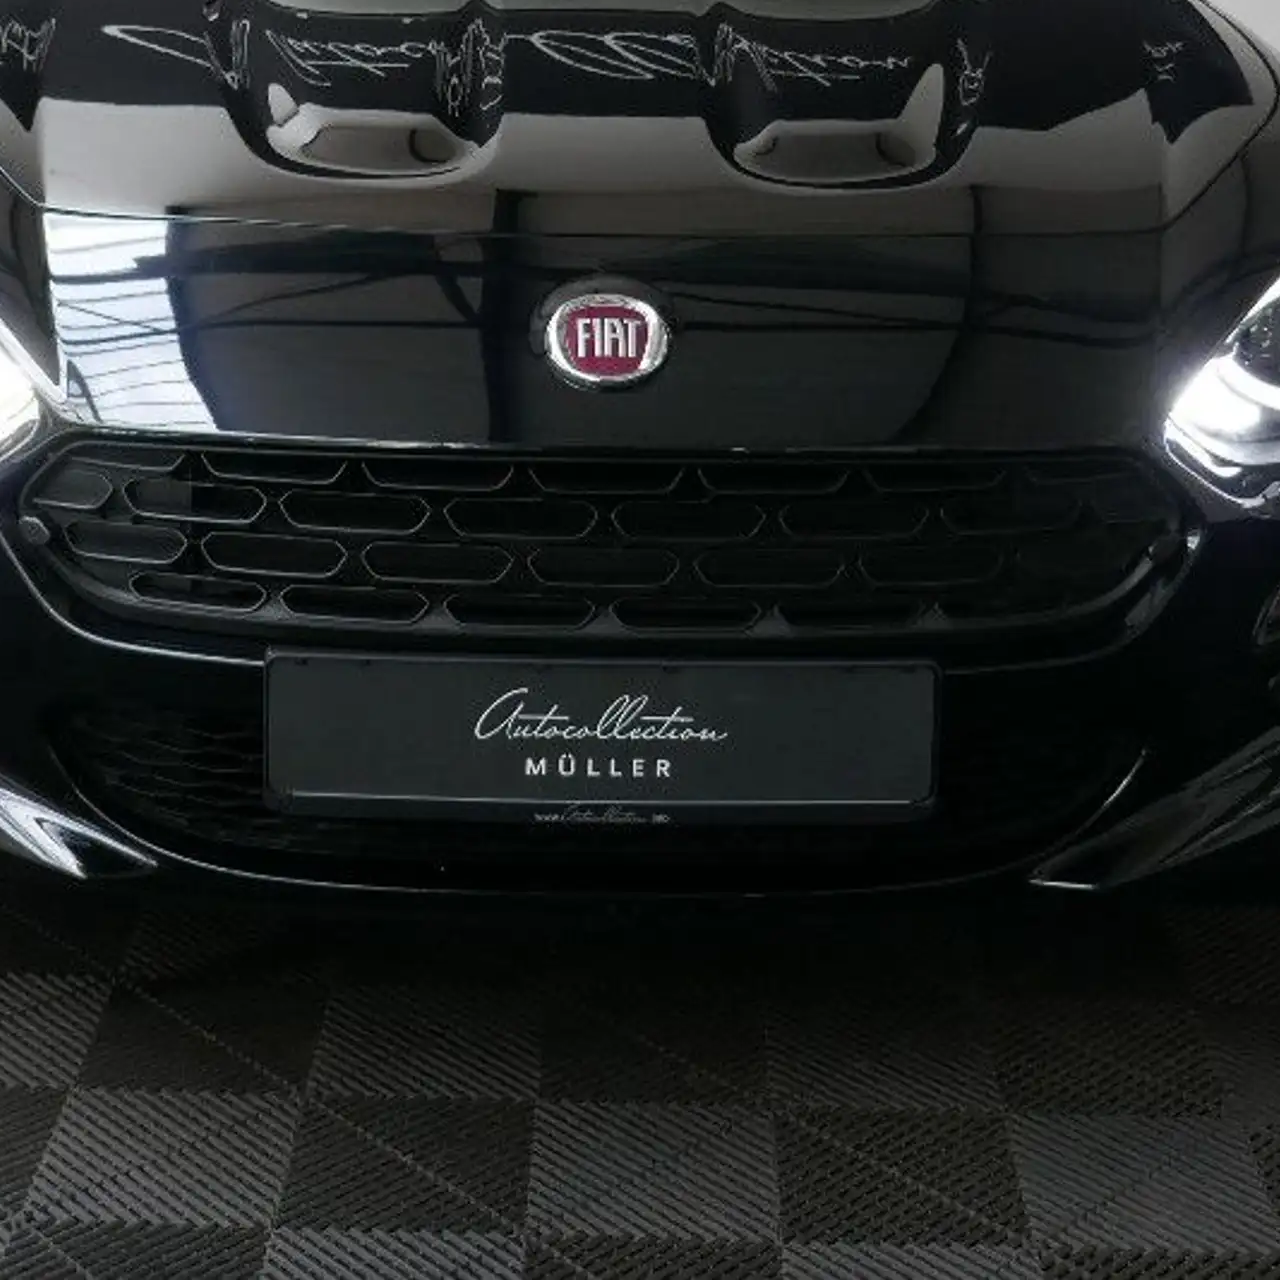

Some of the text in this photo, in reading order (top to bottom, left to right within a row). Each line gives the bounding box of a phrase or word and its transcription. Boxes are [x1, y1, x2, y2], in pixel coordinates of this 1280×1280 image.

[576, 318, 641, 357] FIAT
[474, 687, 728, 741] Autocollection
[525, 753, 671, 778] MÜLLER
